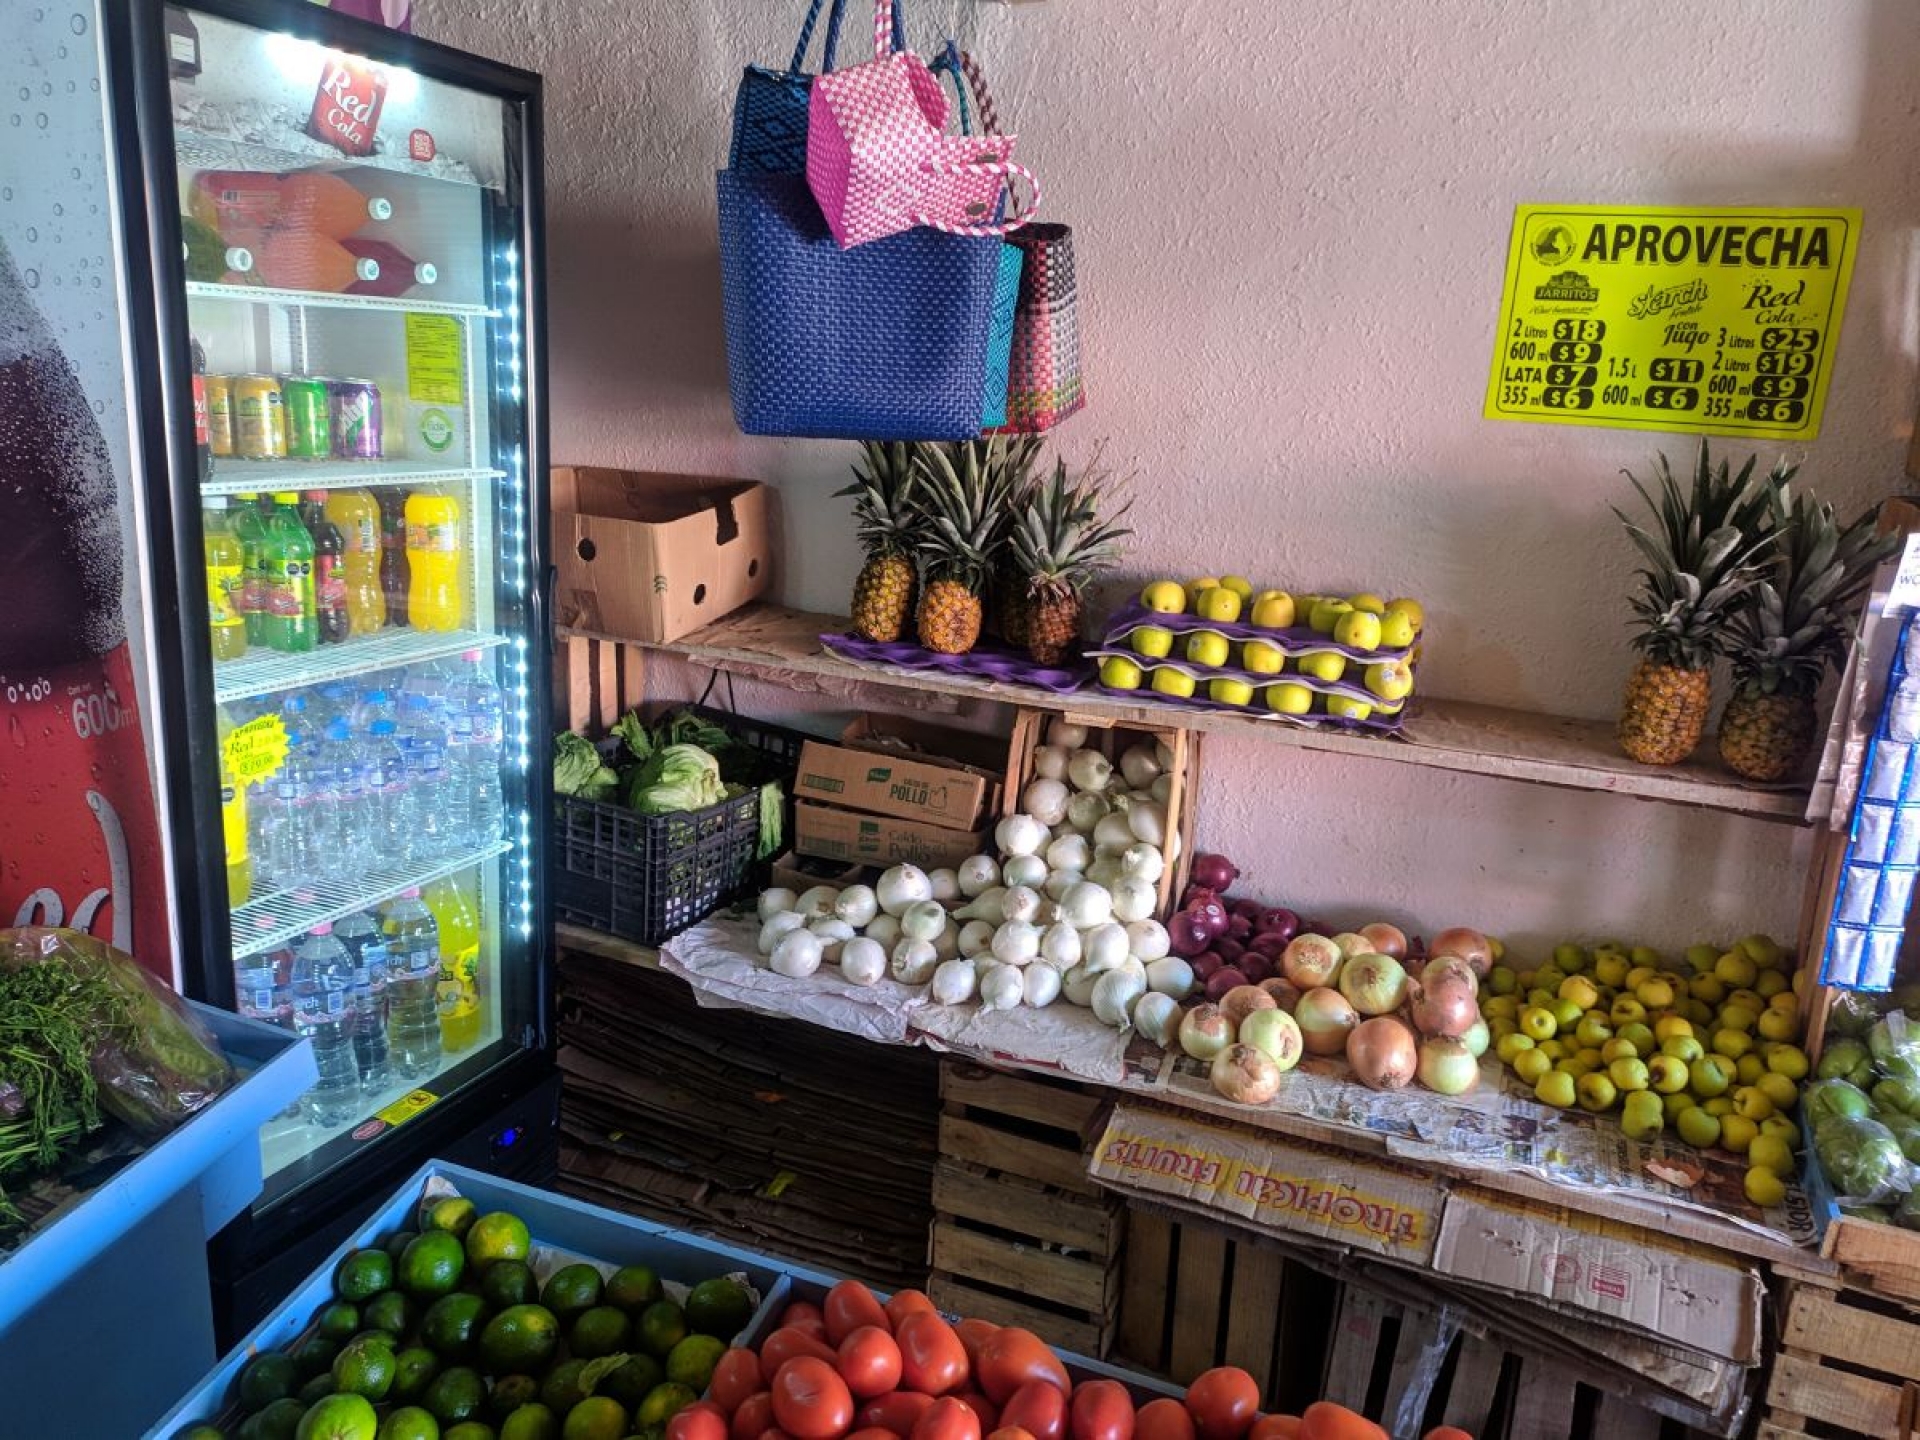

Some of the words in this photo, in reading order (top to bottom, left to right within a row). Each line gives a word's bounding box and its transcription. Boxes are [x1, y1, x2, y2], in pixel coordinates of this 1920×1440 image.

[322, 65, 377, 127] Red
[327, 108, 363, 145] Cola
[1583, 222, 1830, 267] APROVECHA
[1536, 287, 1598, 301] JARRITOS
[1742, 279, 1806, 310] Red
[1676, 321, 1699, 331] con
[1754, 309, 1794, 325] Cola
[1513, 318, 1523, 338] 2
[1524, 326, 1548, 339] Litros
[1556, 319, 1599, 343] $18
[1663, 324, 1710, 354] Jugo
[1716, 327, 1727, 348] 3
[1729, 335, 1755, 349] Litros
[1763, 329, 1813, 351] $25
[1510, 341, 1537, 360] 600
[1537, 350, 1550, 363] ml
[1712, 350, 1723, 371] 2
[1725, 358, 1750, 372] Litros
[1759, 352, 1807, 375] $19
[1505, 366, 1542, 383] LATA
[1608, 357, 1630, 379] 1.5
[1655, 360, 1699, 382] $11
[1502, 385, 1529, 405] 355
[1529, 393, 1542, 407] ml
[1602, 385, 1629, 406] 600
[1630, 394, 1643, 407] ml
[1708, 375, 1737, 395] 600
[1738, 383, 1752, 396] ml
[1704, 397, 1732, 418] 355
[1734, 406, 1748, 419] ml
[889, 783, 928, 806] POLLO
[1103, 1138, 1222, 1185] FRUITS
